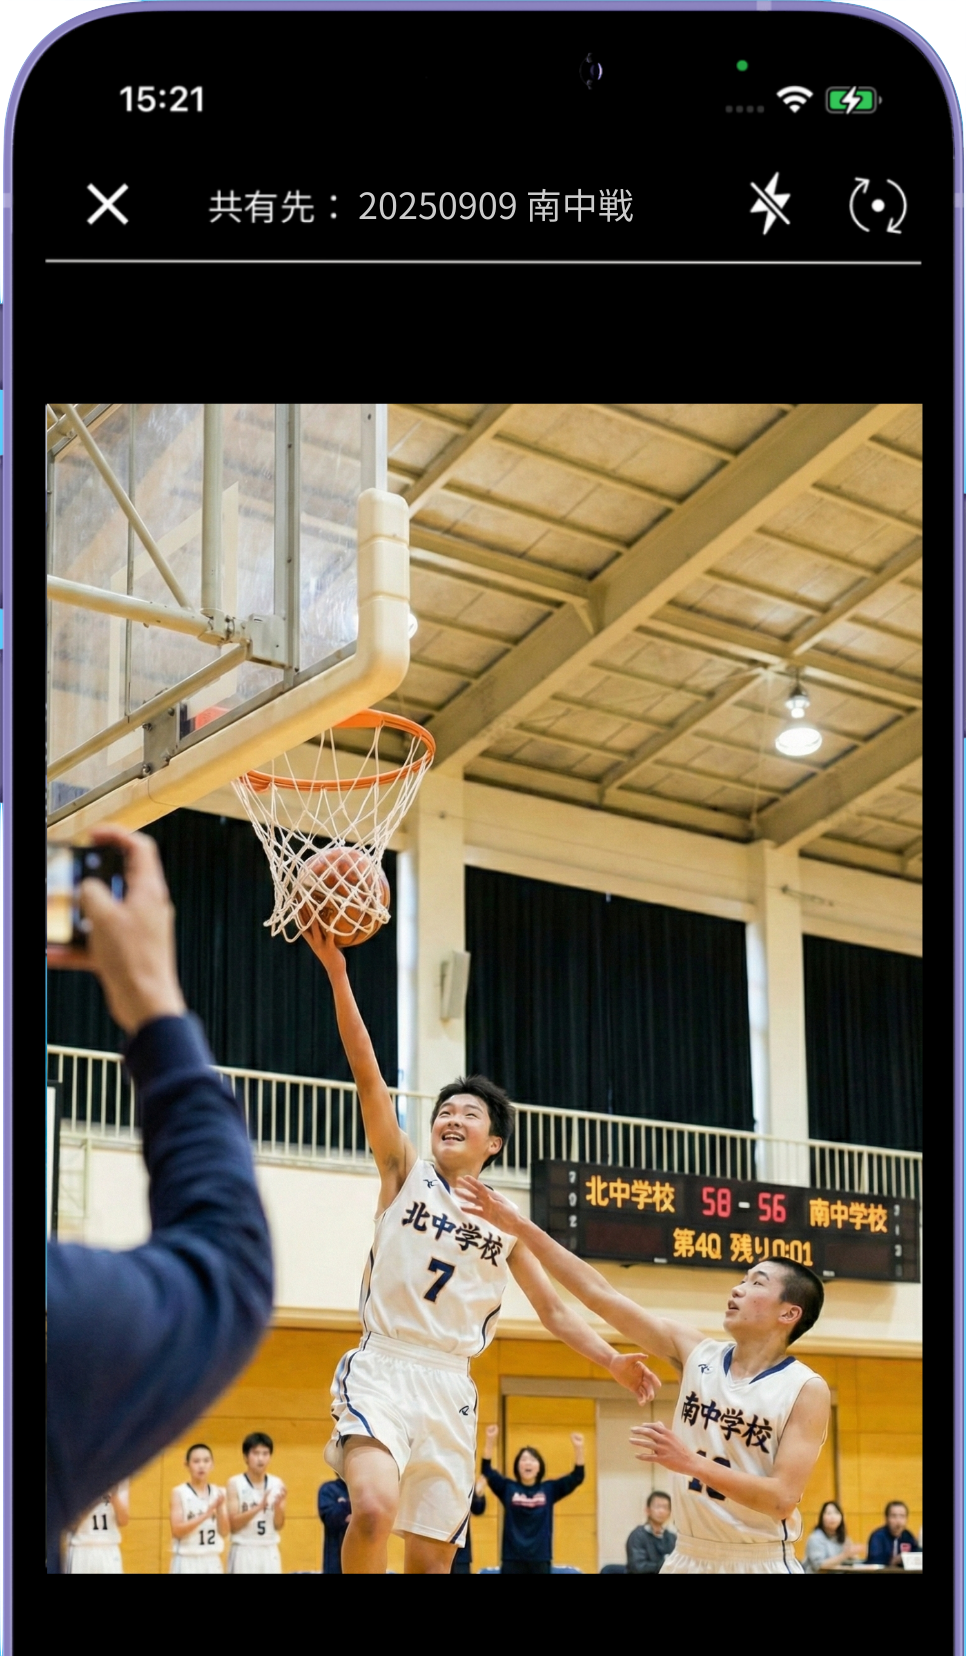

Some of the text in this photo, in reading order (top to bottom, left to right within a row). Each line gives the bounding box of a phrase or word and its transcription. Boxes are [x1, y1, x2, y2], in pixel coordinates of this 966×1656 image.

[119, 85, 203, 113] 15:21
[358, 191, 517, 221] 20250909
[527, 188, 634, 223] 南中戦
[585, 1174, 676, 1214] 北中学校
[702, 1186, 732, 1218] 58
[758, 1192, 787, 1224] 56
[809, 1197, 888, 1233] 南中学校
[401, 1200, 503, 1267] 北中学校
[672, 1227, 722, 1260] 第4Q
[423, 1257, 456, 1303] 7
[681, 1390, 773, 1454] 南中学校
[92, 1513, 108, 1531] 11
[199, 1529, 216, 1546] 12
[257, 1520, 266, 1536] 5
